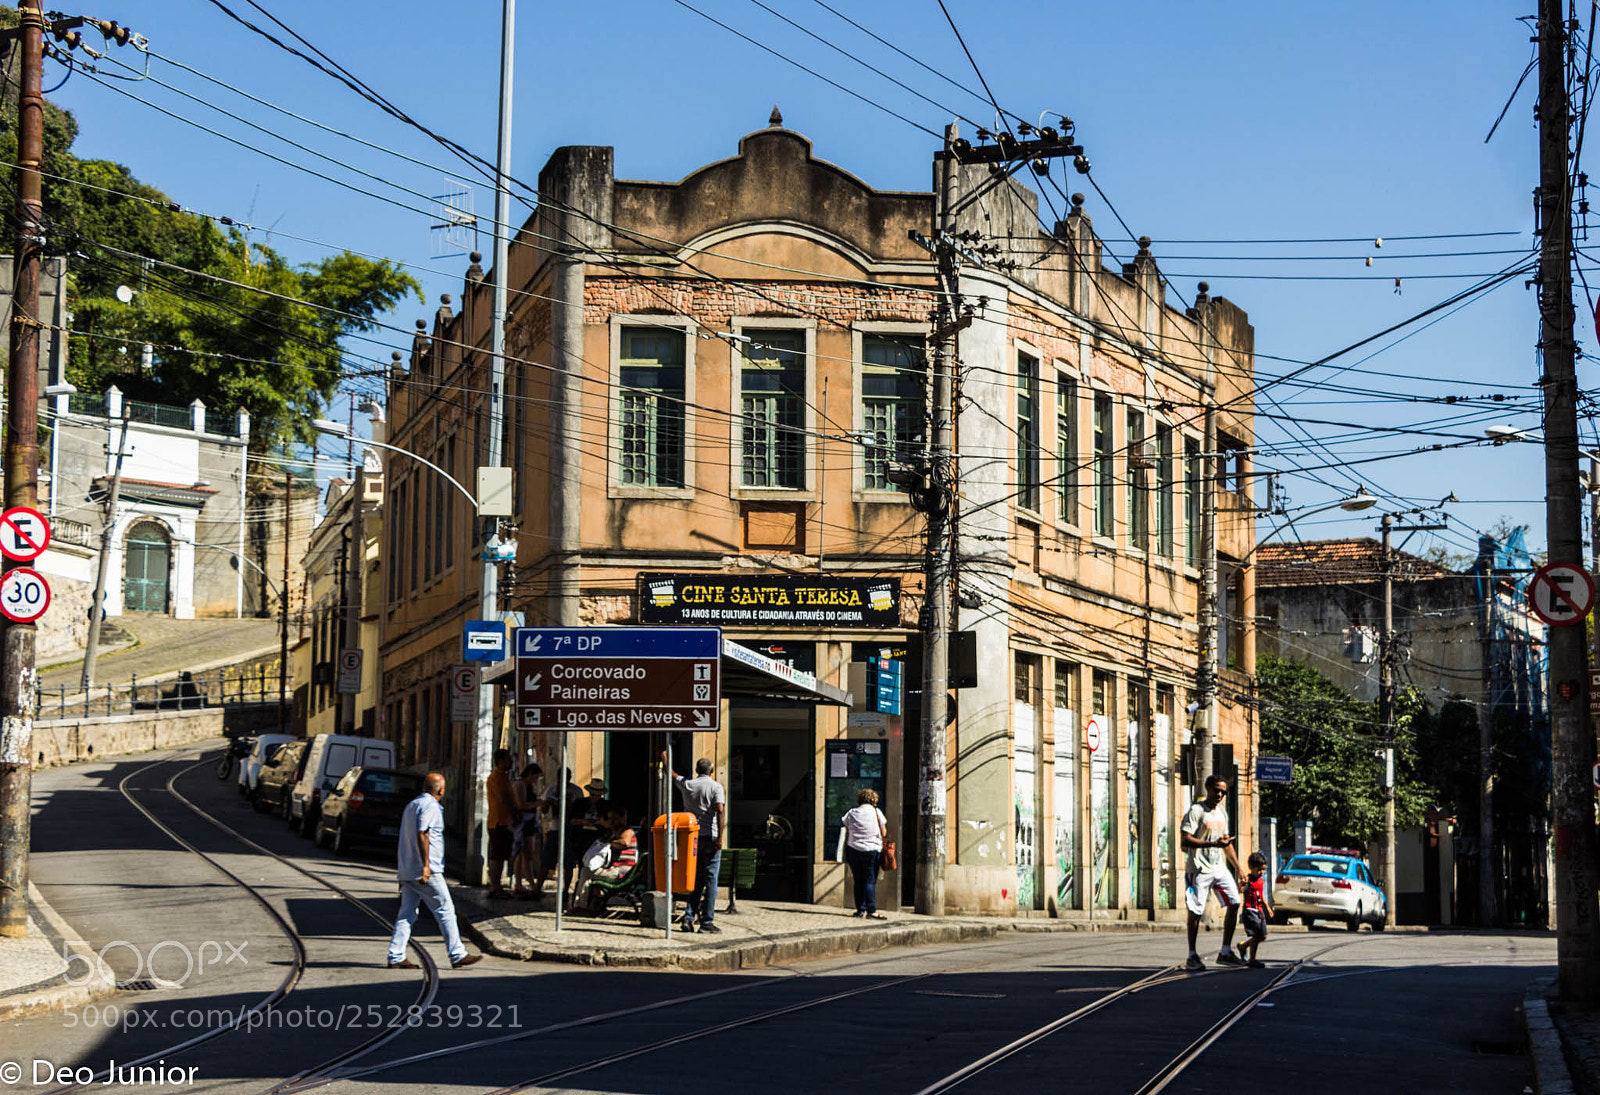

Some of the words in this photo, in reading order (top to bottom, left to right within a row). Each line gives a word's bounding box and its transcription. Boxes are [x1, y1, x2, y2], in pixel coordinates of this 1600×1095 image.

[7, 581, 41, 604] 30
[681, 585, 725, 603] CINE
[730, 586, 791, 606] SANTA
[794, 587, 863, 606] TERESA
[681, 609, 690, 618] 13
[691, 609, 710, 618] ANOS
[711, 609, 720, 618] DE
[721, 609, 752, 619] CULTURA
[752, 610, 758, 619] E
[758, 610, 794, 620] CIDADANIA
[795, 609, 825, 620] ATRAVÉS
[825, 611, 836, 620] DO
[836, 611, 863, 621] CINEMA
[577, 636, 602, 651] DP
[550, 664, 647, 680] Corcovado
[461, 673, 471, 688] E
[550, 683, 631, 700] Paineiras
[557, 709, 593, 727] Lgo.
[595, 709, 626, 724] das
[630, 709, 683, 724] Neves
